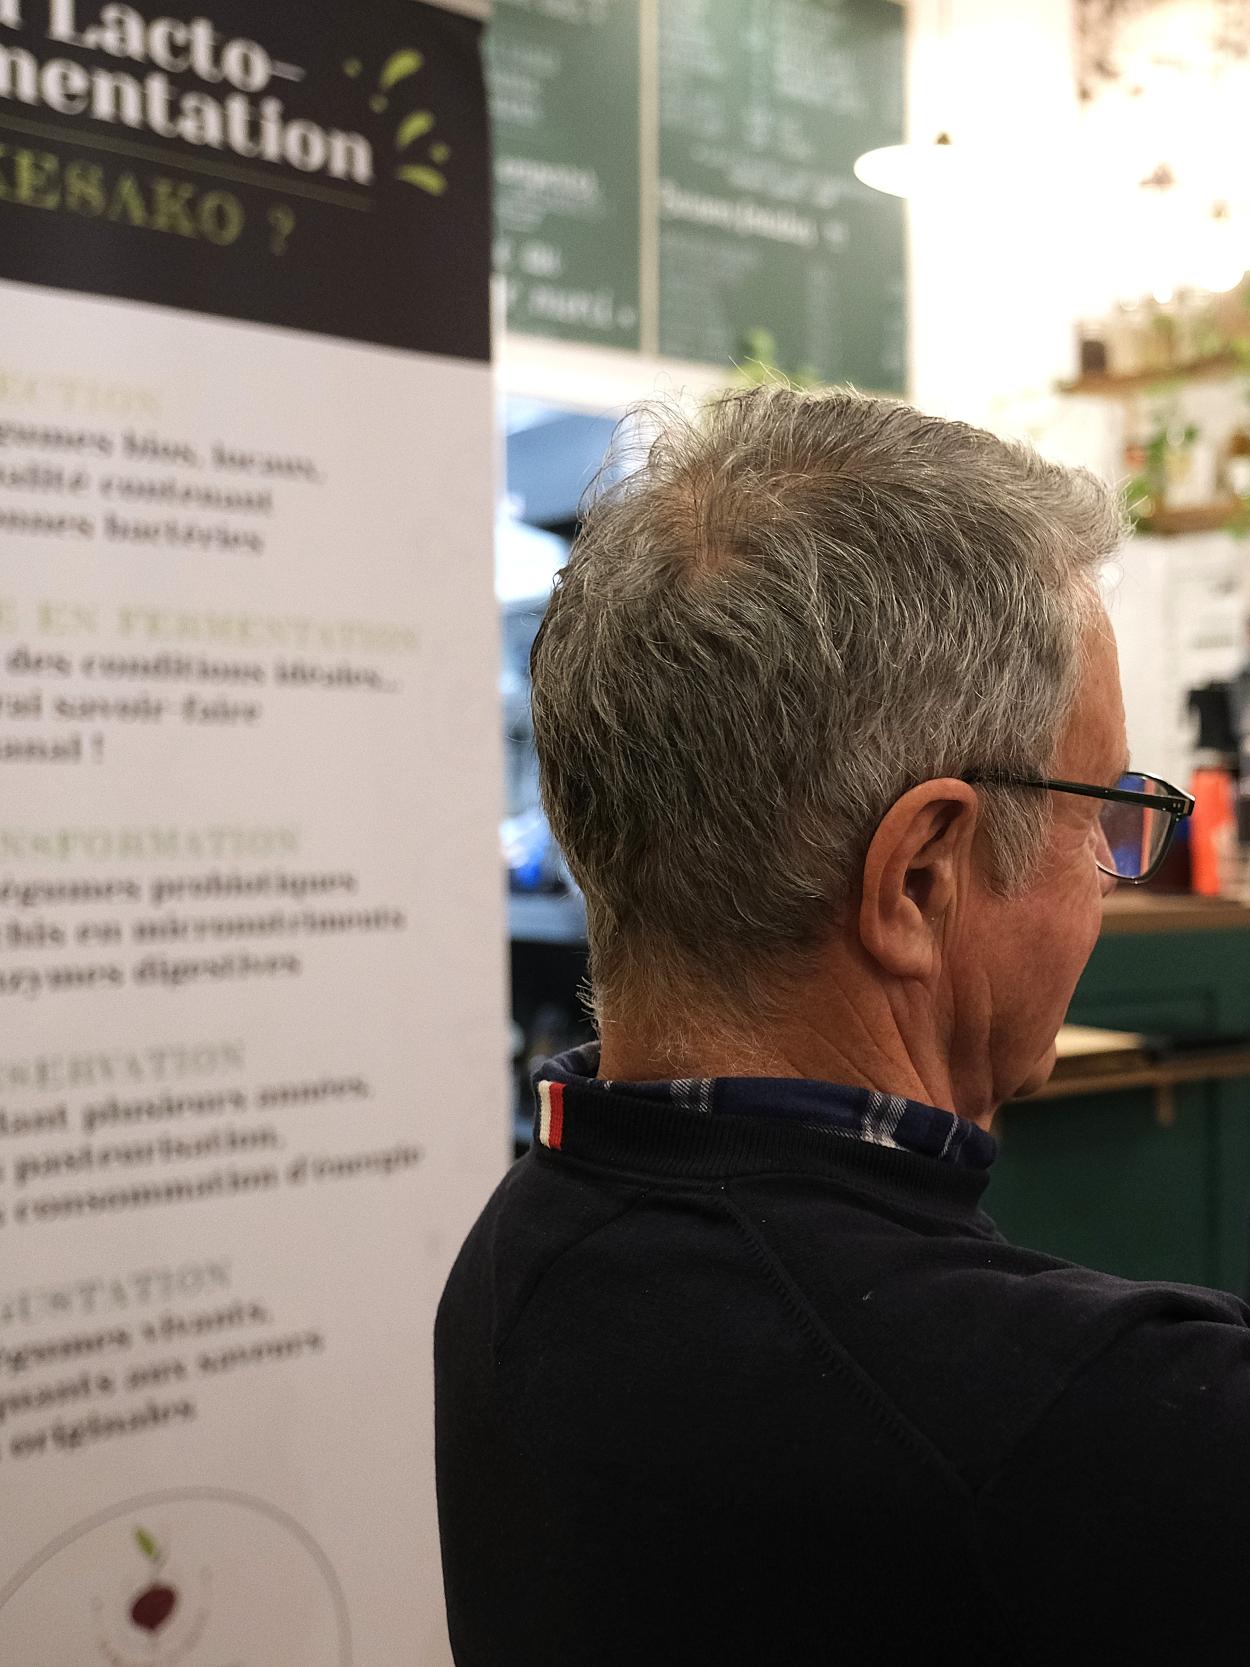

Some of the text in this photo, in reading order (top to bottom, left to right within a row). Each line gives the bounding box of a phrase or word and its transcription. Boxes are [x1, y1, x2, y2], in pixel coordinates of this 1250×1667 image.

[48, 0, 305, 92] Lacto-
[268, 202, 296, 256] ?
[6, 642, 71, 678] des
[81, 648, 265, 685] conditions
[0, 1038, 245, 1090] SERVATION
